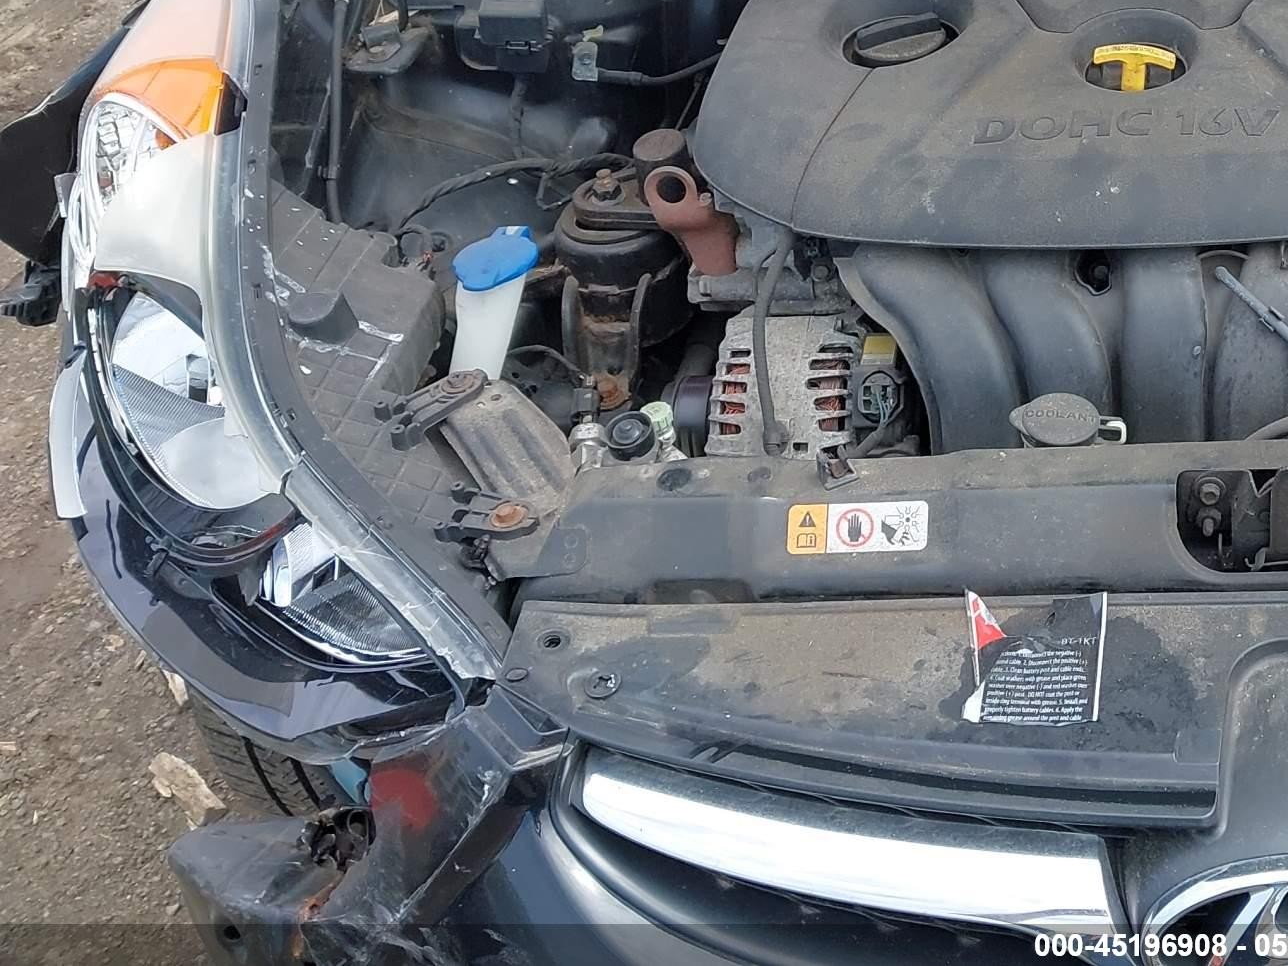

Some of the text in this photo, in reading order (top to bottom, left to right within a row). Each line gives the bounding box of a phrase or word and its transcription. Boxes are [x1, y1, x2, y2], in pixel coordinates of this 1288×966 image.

[971, 108, 1280, 144] DOHC 16V
[1025, 410, 1096, 422] COOLANT
